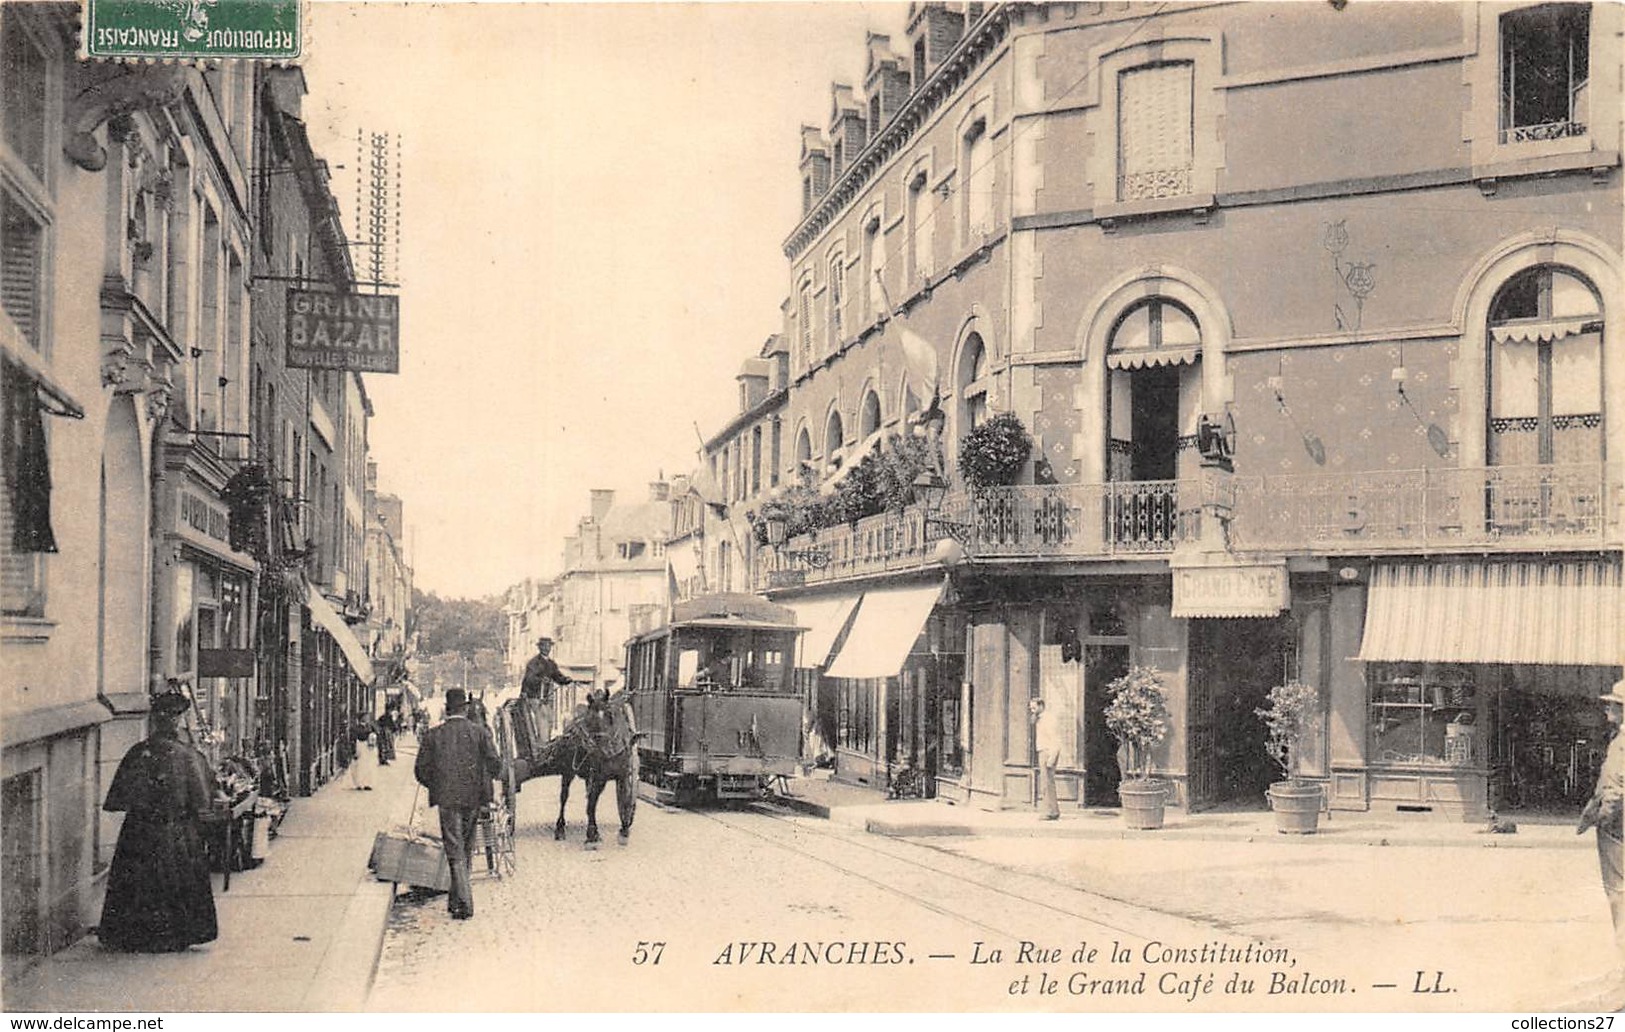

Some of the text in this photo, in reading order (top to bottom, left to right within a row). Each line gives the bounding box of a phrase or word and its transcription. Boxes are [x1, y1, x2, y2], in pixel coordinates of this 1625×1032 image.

[98, 27, 179, 49] FRANÇAISE
[293, 292, 397, 320] GRAND
[291, 314, 392, 352] BAZAR
